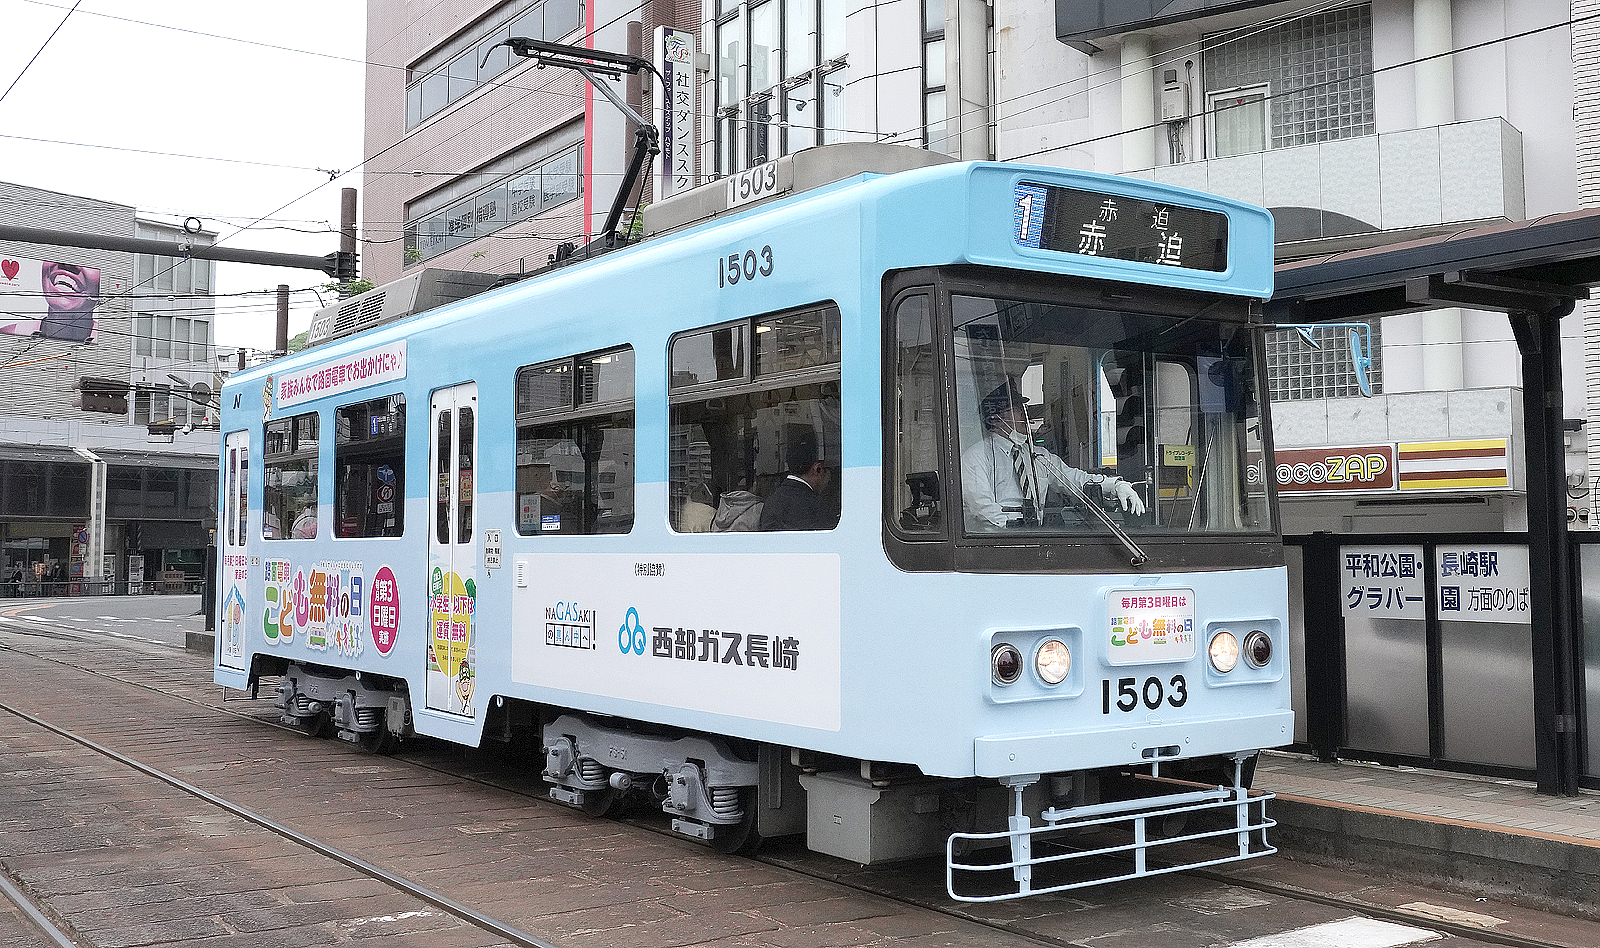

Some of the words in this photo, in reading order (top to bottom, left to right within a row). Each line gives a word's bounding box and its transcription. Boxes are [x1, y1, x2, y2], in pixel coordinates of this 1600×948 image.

[729, 163, 776, 202] 1503
[1018, 193, 1033, 240] 1
[1099, 198, 1118, 222] 赤
[1150, 206, 1169, 231] 迫
[1078, 219, 1107, 256] 赤
[1156, 231, 1183, 265] 迫
[718, 245, 774, 288] 1503
[1440, 551, 1499, 579] 長崎駅
[263, 569, 363, 639] こども無料の日
[373, 605, 396, 628] 日曜日
[1121, 596, 1187, 609] 毎月第3日曜日は
[1346, 585, 1424, 611] グラバー
[1440, 585, 1461, 612] 園
[1467, 586, 1529, 612] 方面のりば
[652, 626, 800, 671] 西部ガス長崎
[1111, 618, 1193, 647] こども無料の日
[1101, 674, 1189, 715] 1503
